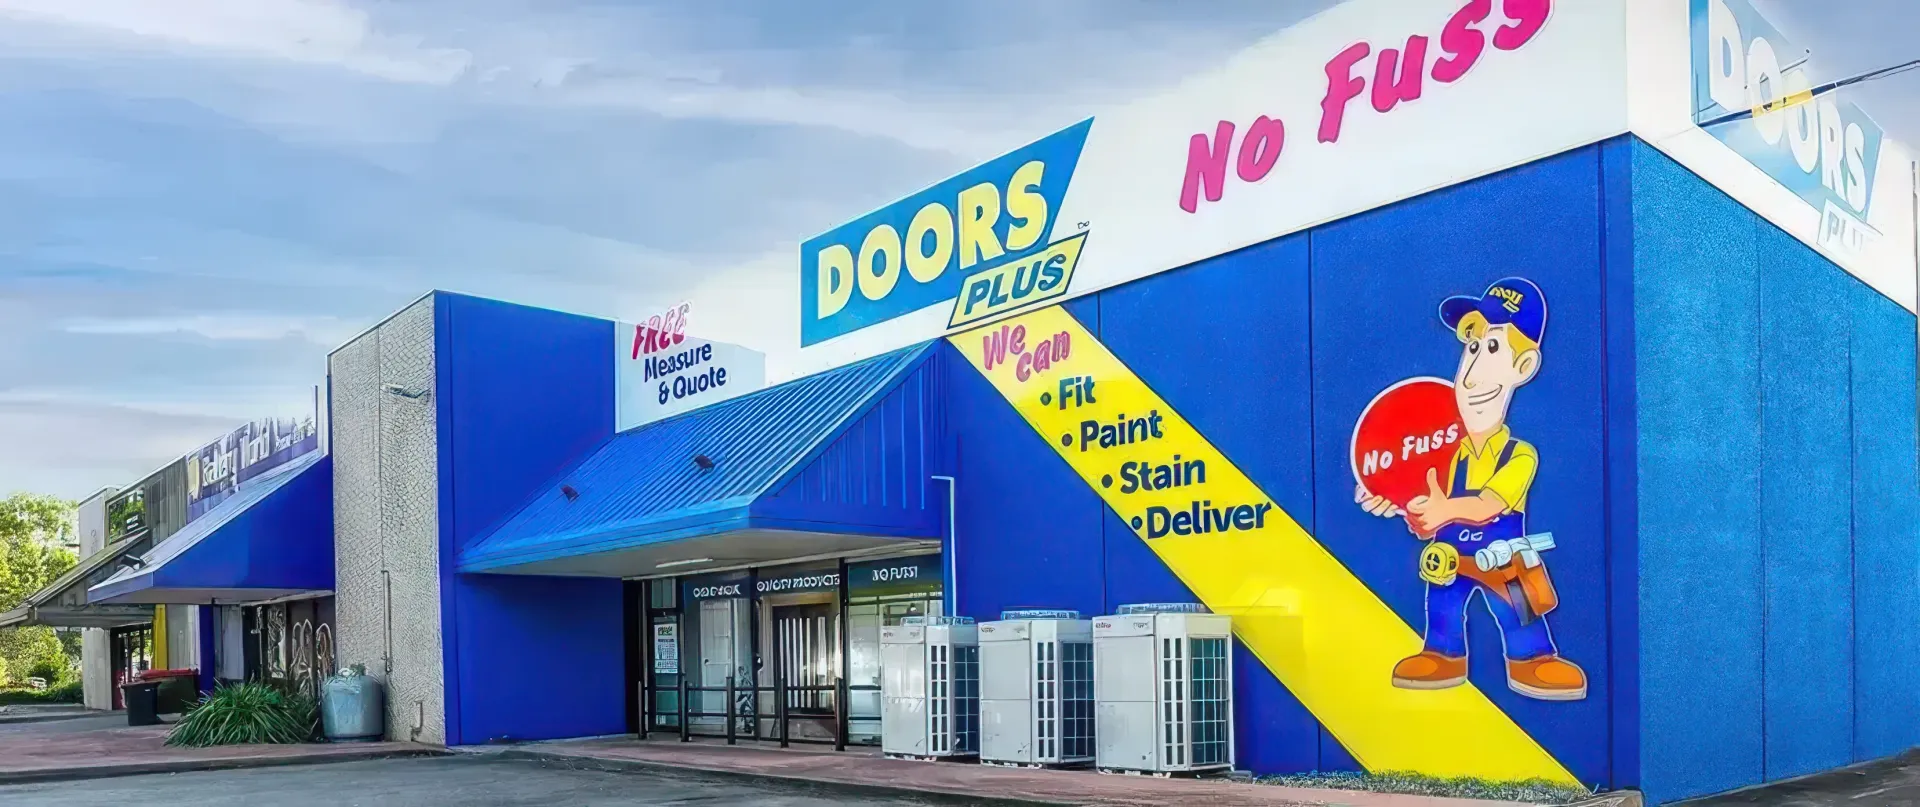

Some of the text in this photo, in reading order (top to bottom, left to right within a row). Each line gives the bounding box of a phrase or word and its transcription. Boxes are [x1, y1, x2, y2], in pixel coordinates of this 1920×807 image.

[1708, 0, 1867, 214] DOORS
[817, 160, 1048, 320] DOORS
[963, 252, 1067, 316] PLUS
[632, 302, 690, 360] FREE
[982, 324, 1027, 371] We
[644, 343, 713, 382] Measure
[1015, 330, 1071, 383] can
[658, 366, 727, 405] & Quote
[1058, 375, 1097, 410] Fit
[1080, 409, 1164, 452] Paint
[1120, 454, 1206, 494] Stain
[1146, 500, 1272, 540] Deliver
